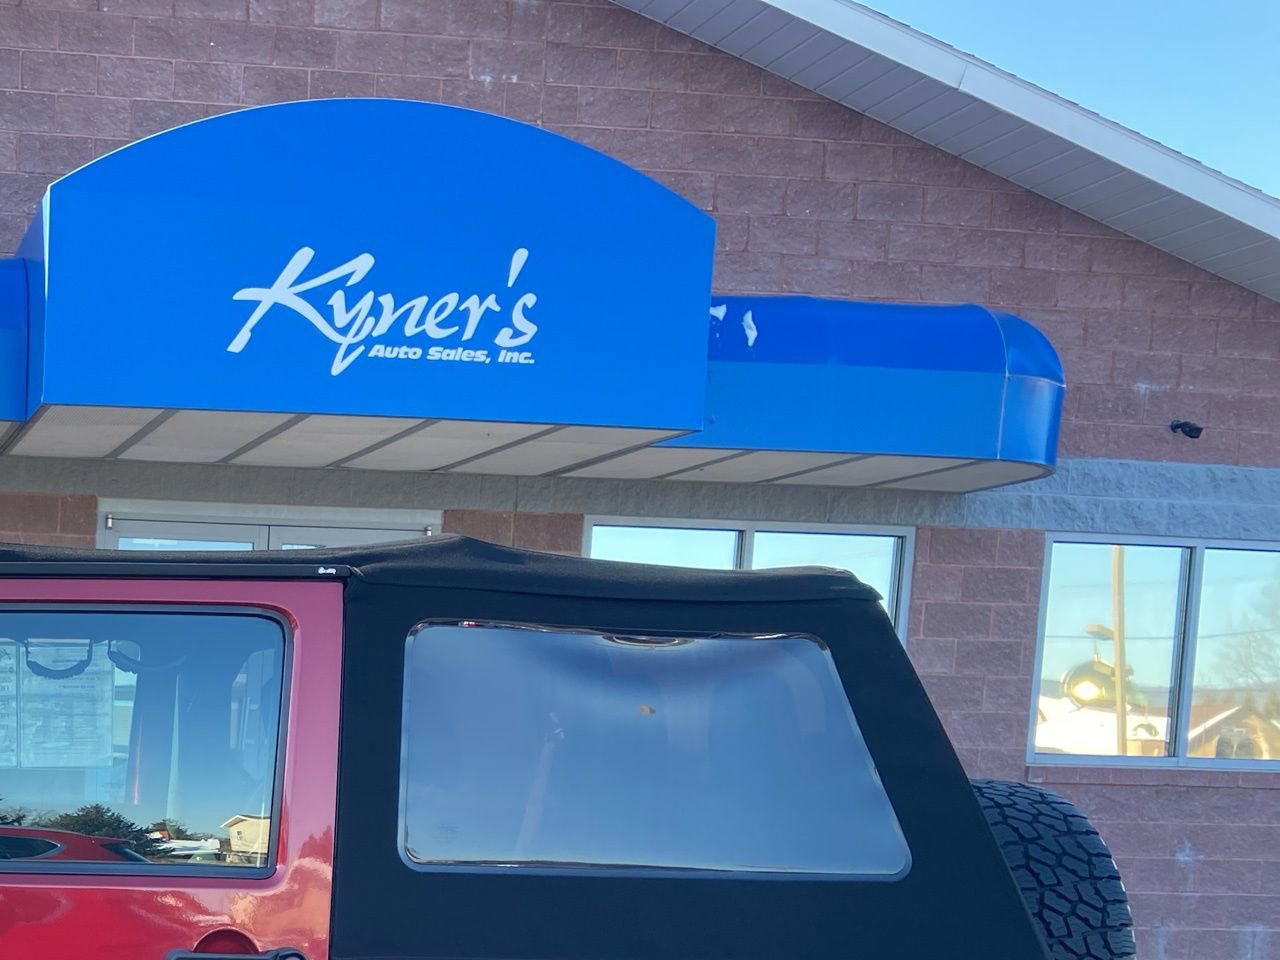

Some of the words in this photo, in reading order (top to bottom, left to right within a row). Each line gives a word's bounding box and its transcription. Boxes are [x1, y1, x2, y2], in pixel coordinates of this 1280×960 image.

[227, 246, 538, 376] Kyner's
[368, 344, 423, 360] Auto
[427, 346, 491, 364] Sales,
[498, 349, 535, 364] Inc.
